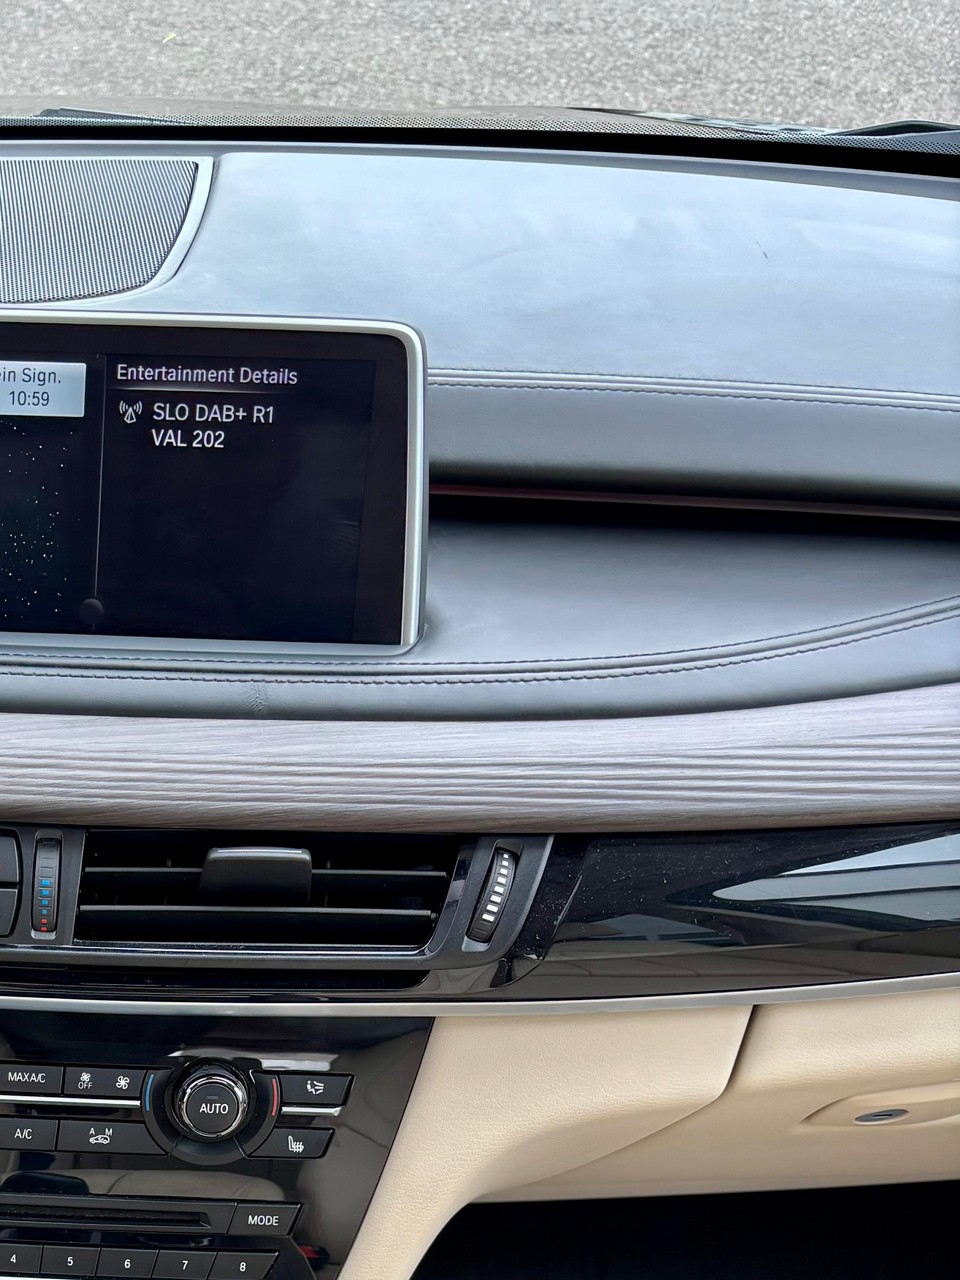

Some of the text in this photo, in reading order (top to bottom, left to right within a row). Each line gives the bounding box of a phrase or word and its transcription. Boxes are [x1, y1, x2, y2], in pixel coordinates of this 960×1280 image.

[22, 367, 61, 386] Sign.
[117, 364, 298, 385] Entertainment Details
[8, 391, 49, 407] 10:59
[153, 403, 274, 423] SLO DAB+ R1
[152, 429, 225, 449] VAL 202
[78, 1081, 92, 1090] OFF
[199, 1103, 228, 1114] AUTO
[14, 1128, 32, 1140] A/C
[105, 1128, 113, 1136] M
[248, 1215, 279, 1227] MODE
[10, 1254, 16, 1264] 4
[67, 1256, 73, 1267] 5
[124, 1259, 131, 1270] 6
[182, 1260, 188, 1271] 7
[240, 1262, 246, 1272] 8
